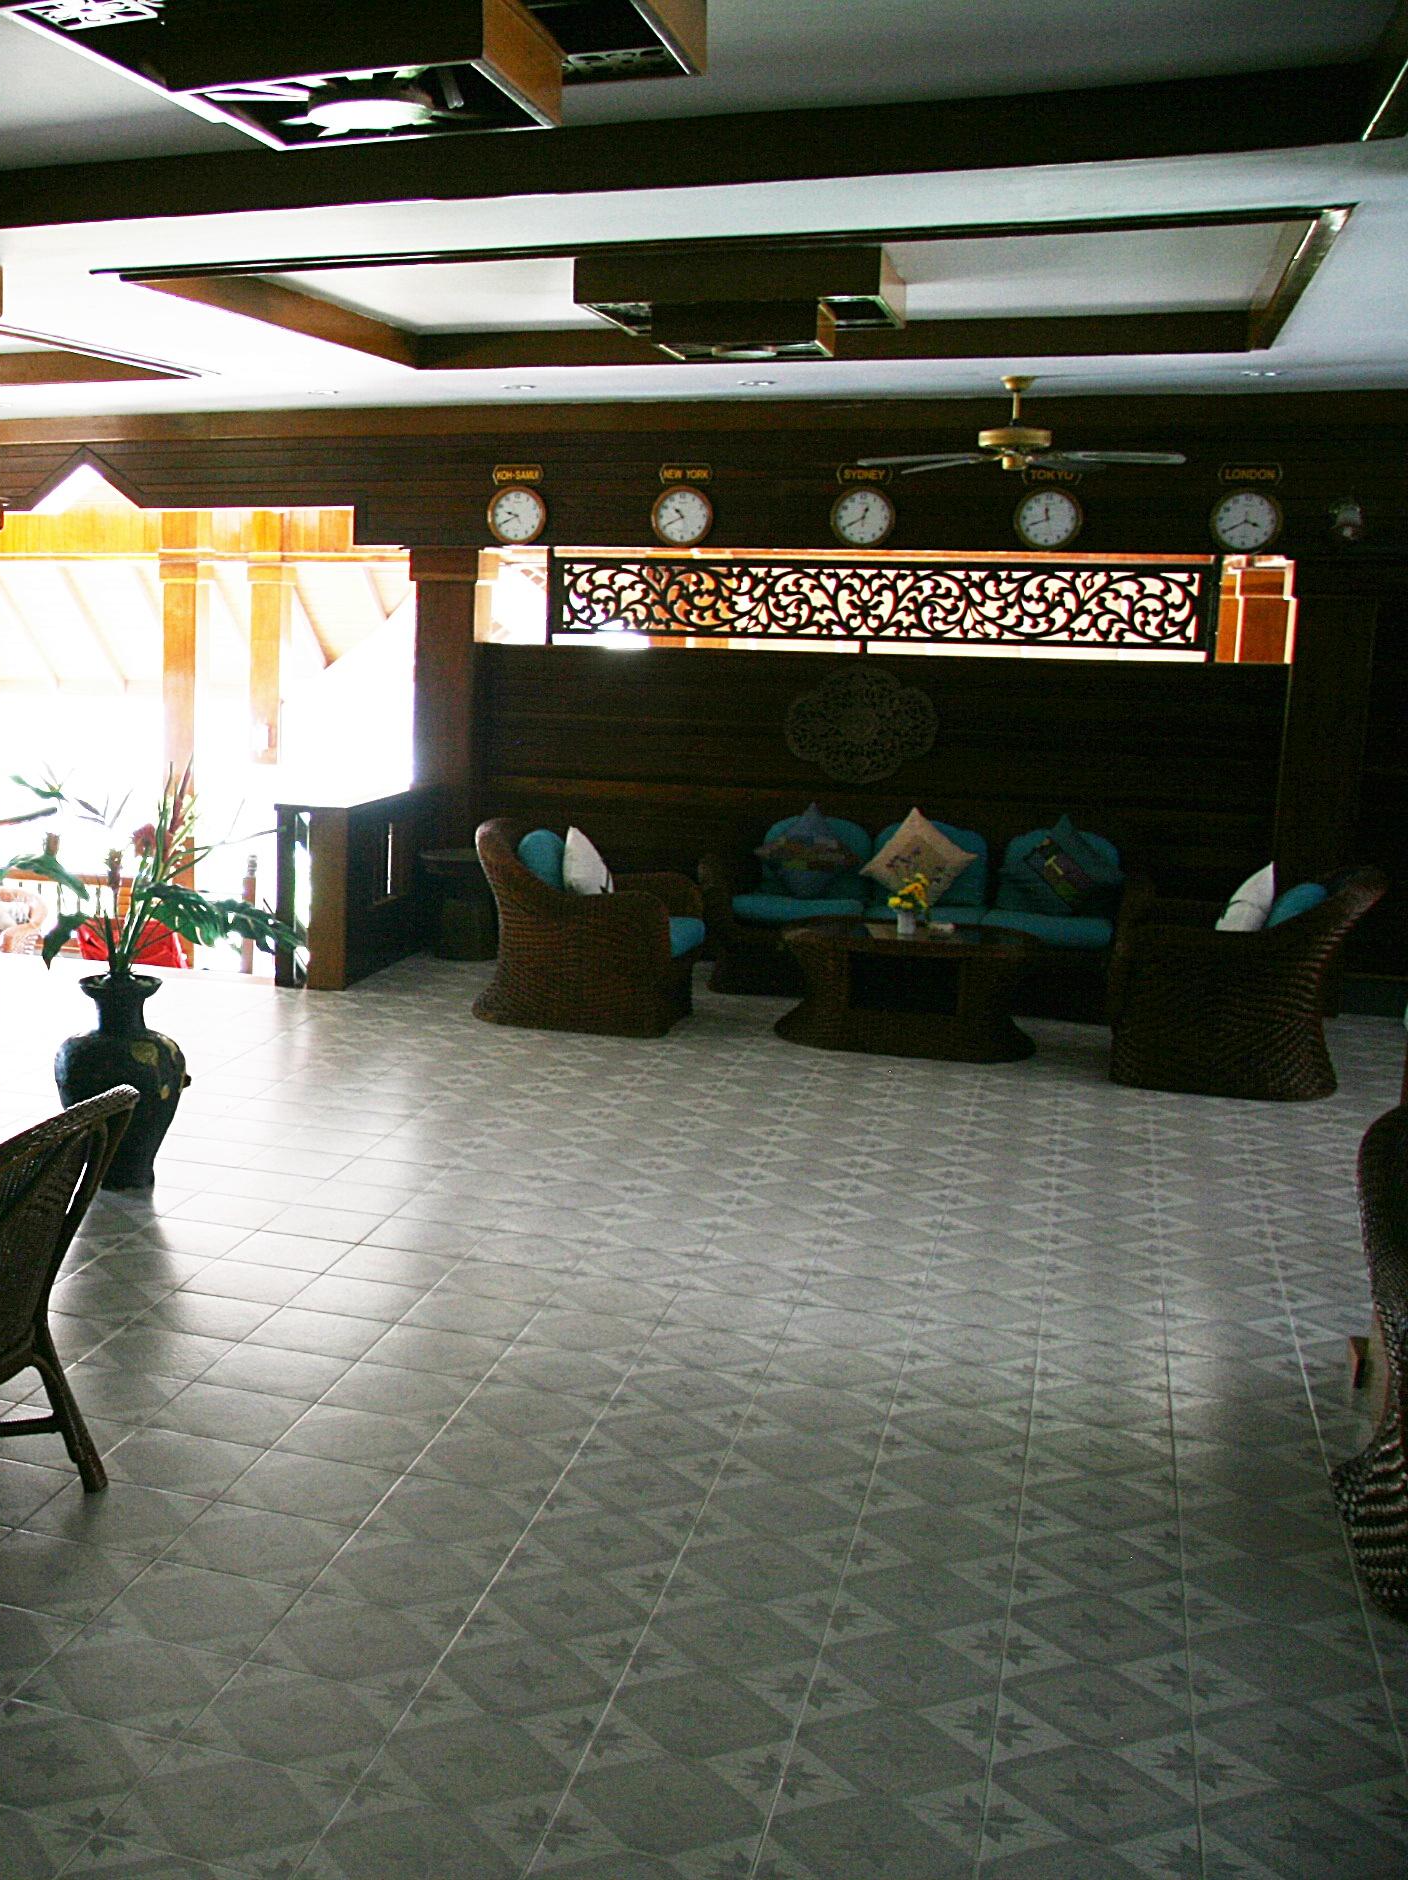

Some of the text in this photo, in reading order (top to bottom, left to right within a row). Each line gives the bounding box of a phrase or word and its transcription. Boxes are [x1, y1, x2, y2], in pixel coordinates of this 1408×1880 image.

[663, 469, 709, 479] NEW YORK
[844, 469, 885, 480] SYDNEY
[1031, 469, 1074, 480] TOKYO
[1224, 468, 1277, 480] LONDON
